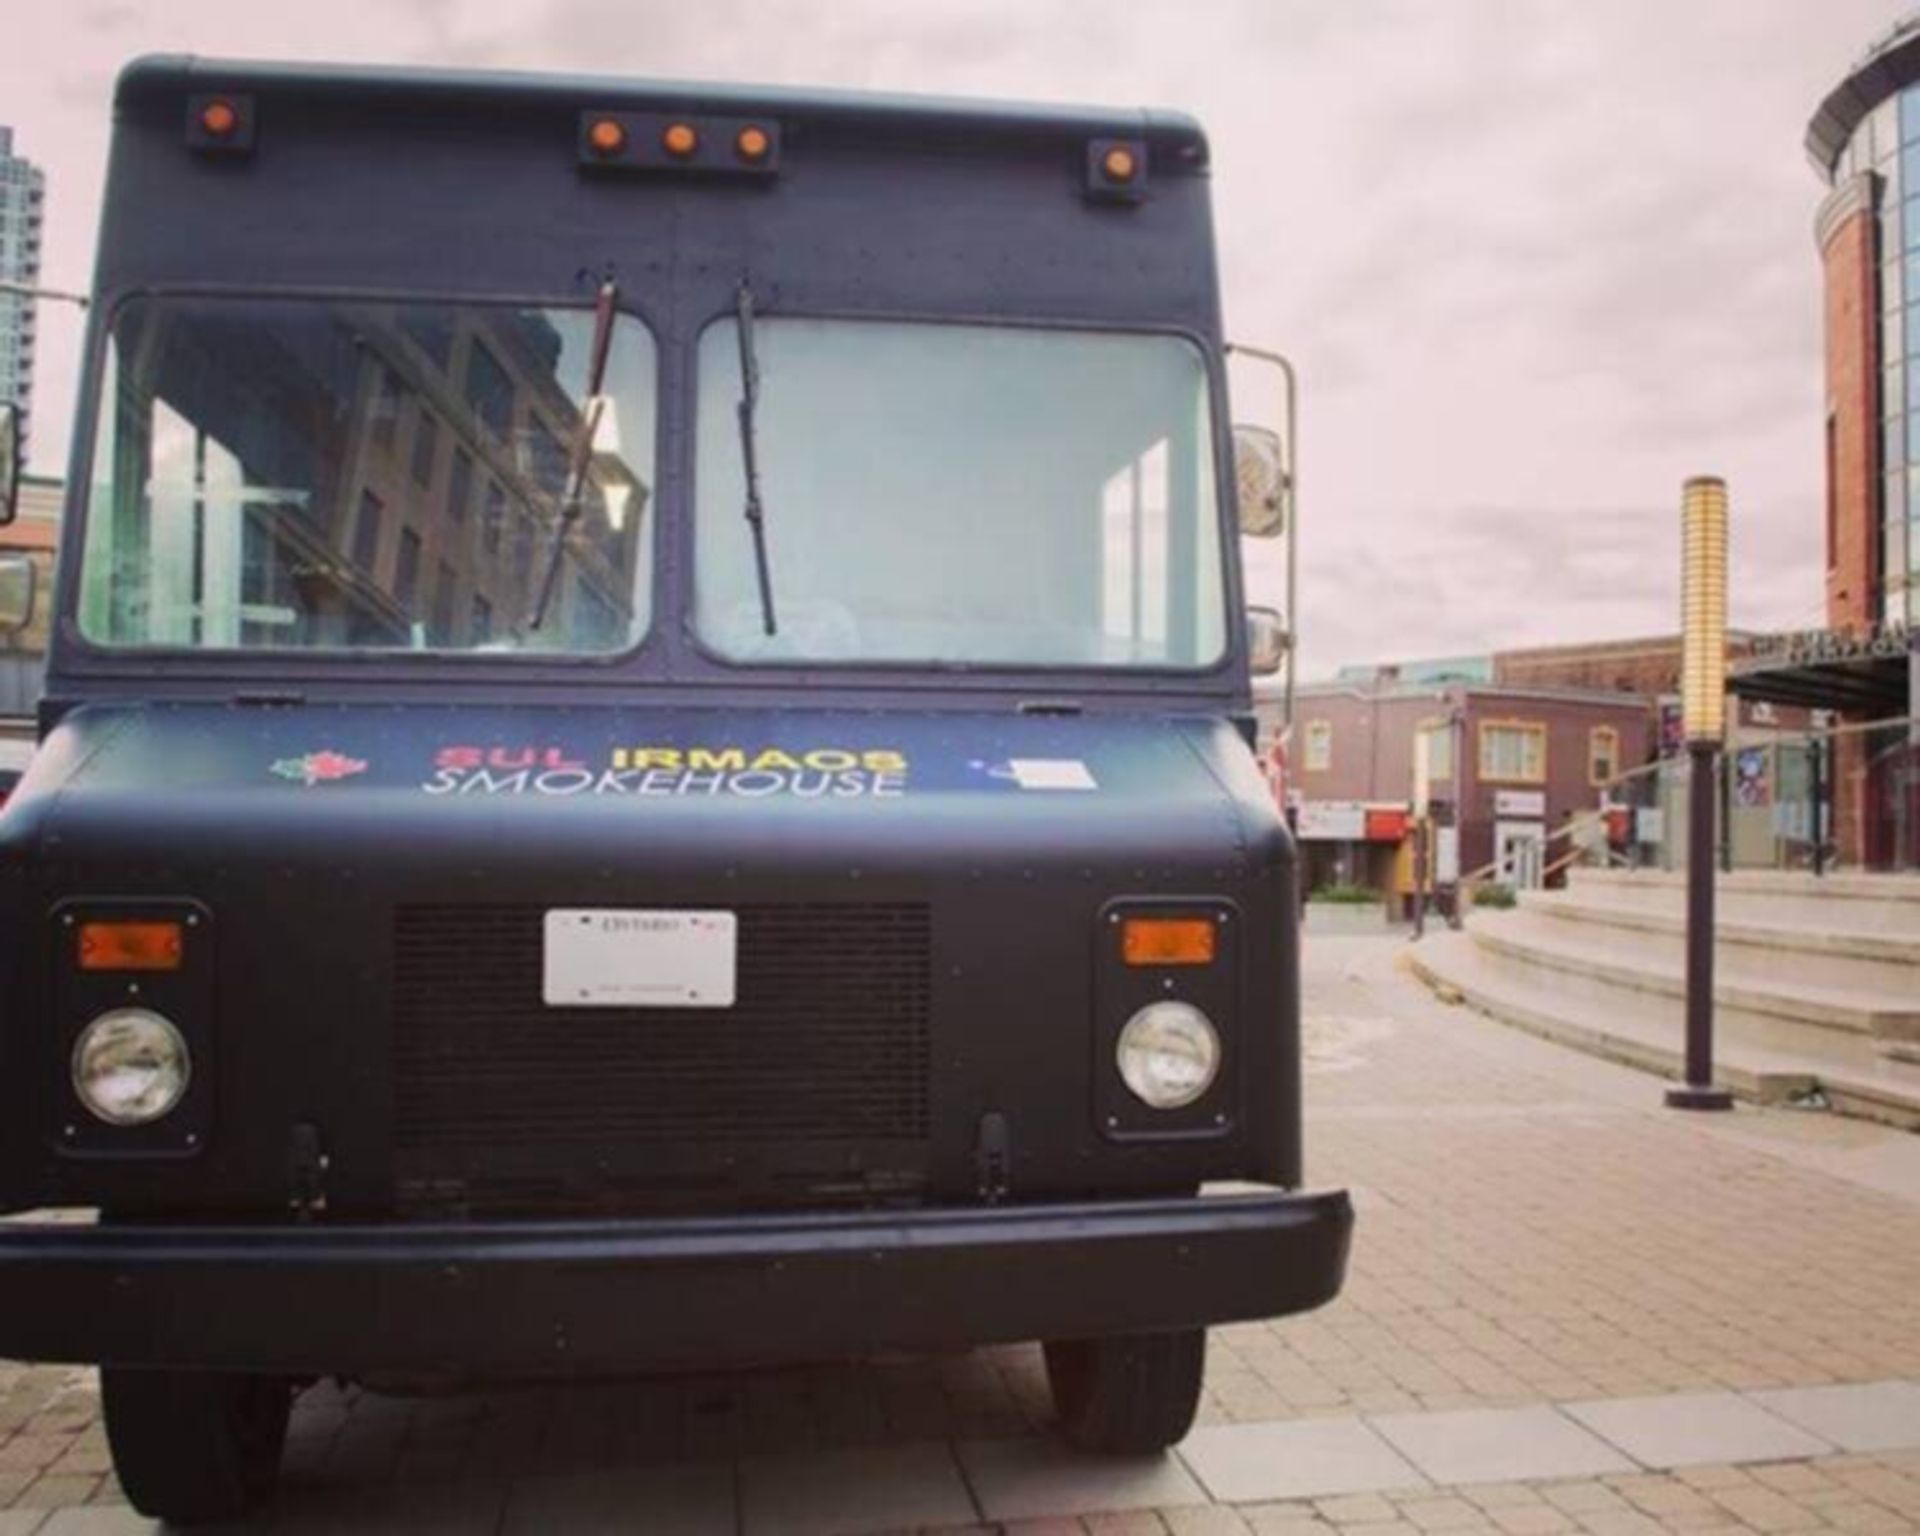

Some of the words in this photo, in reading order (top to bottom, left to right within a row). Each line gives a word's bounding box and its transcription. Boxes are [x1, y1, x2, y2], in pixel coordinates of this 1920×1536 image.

[435, 747, 585, 769] SUL
[611, 748, 907, 771] IRMAOS
[421, 767, 906, 796] SMOKEHOUSE
